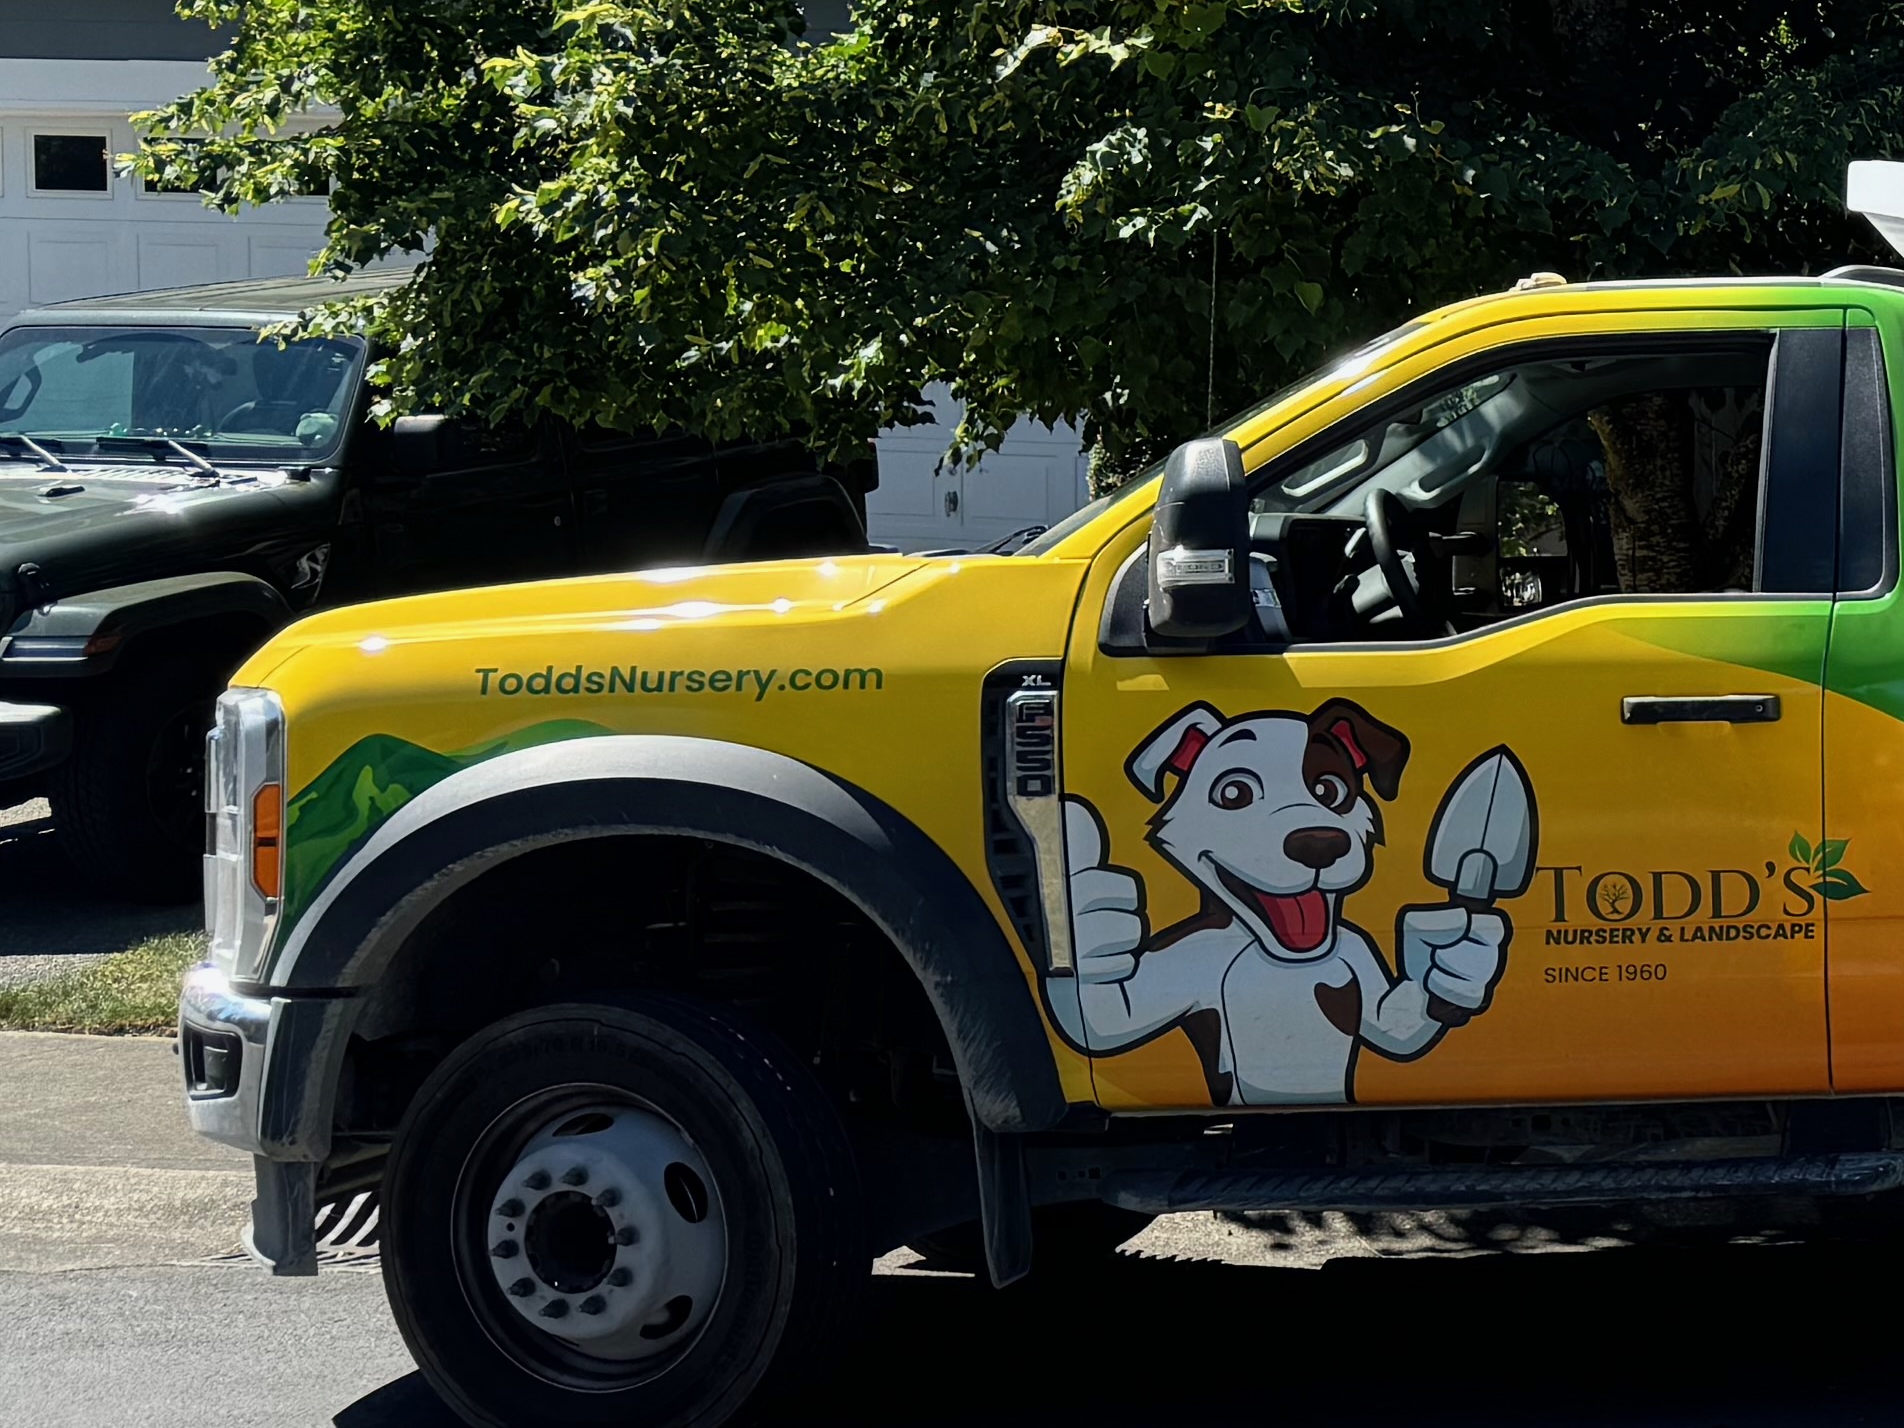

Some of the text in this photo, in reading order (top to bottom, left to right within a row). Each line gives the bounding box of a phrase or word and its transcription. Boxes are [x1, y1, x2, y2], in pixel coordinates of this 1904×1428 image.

[474, 665, 884, 703] ToddsNursery.com
[1021, 674, 1052, 687] XL
[1535, 860, 1816, 923] TODD'S
[1545, 923, 1816, 946] NURSERY & LANDSCAPE
[1544, 963, 1668, 984] SINCE 1960
